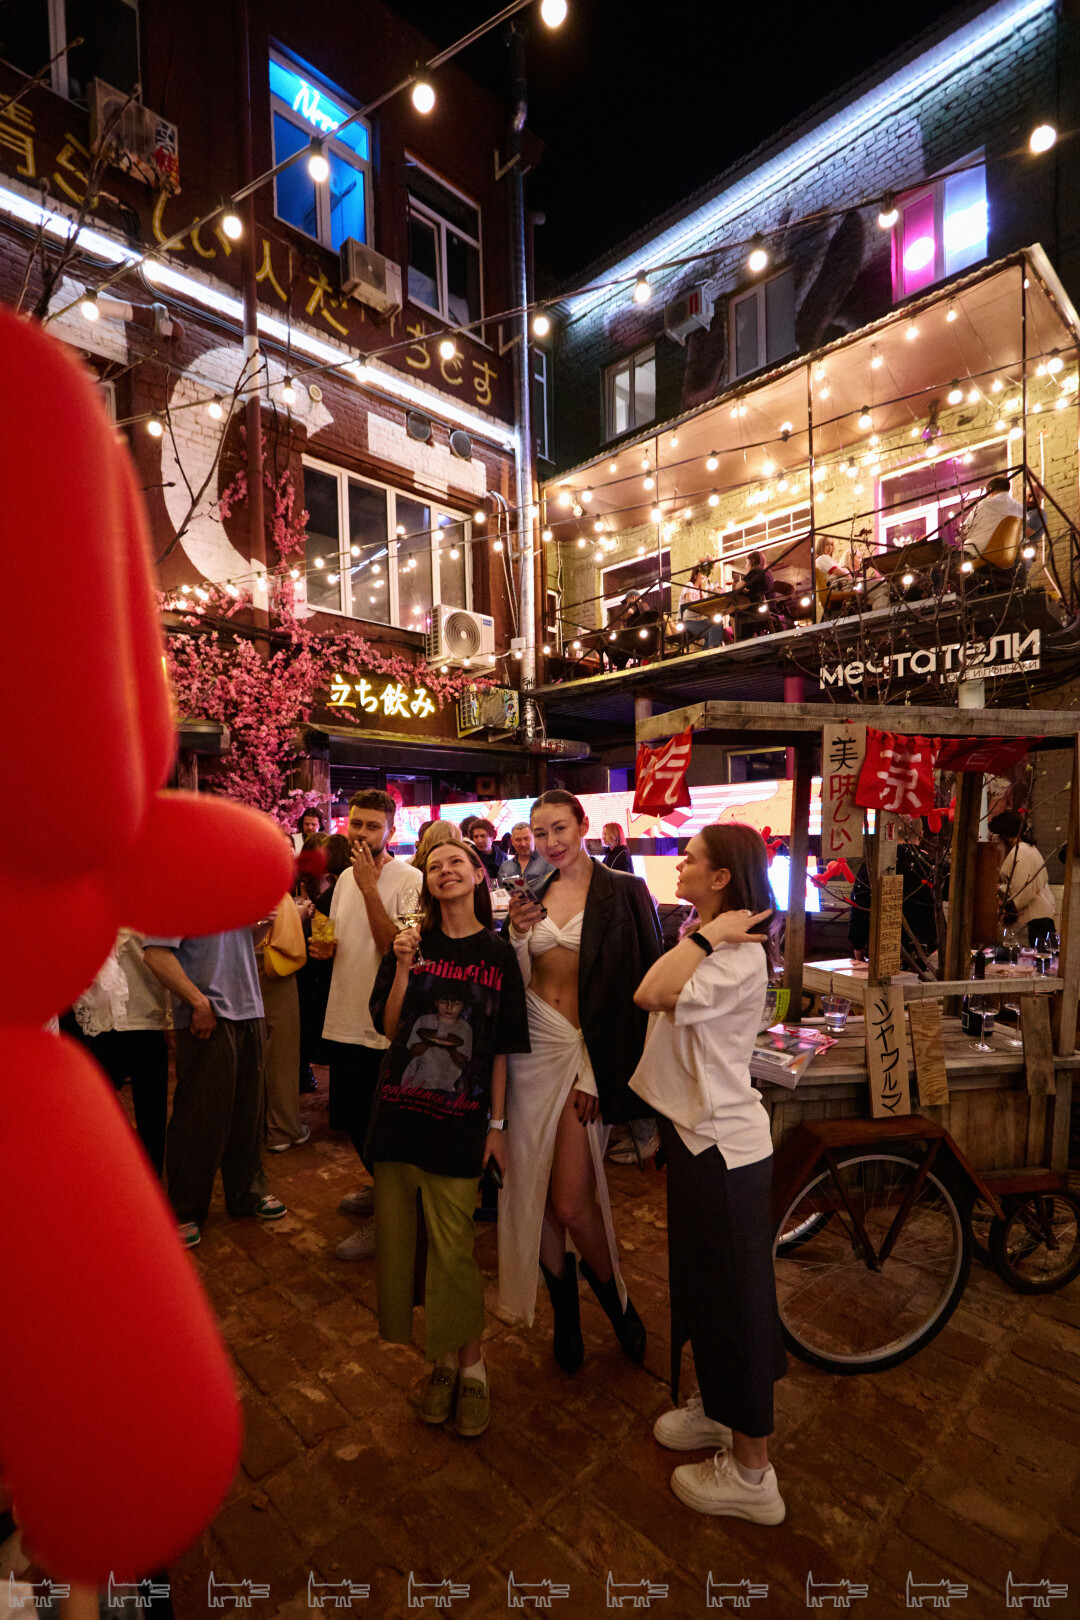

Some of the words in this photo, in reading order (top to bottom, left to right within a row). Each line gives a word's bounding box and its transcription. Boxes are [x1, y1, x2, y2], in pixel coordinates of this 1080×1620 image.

[325, 673, 436, 719] 立ち飲み
[828, 735, 859, 853] 美味しい
[877, 748, 923, 810] 京
